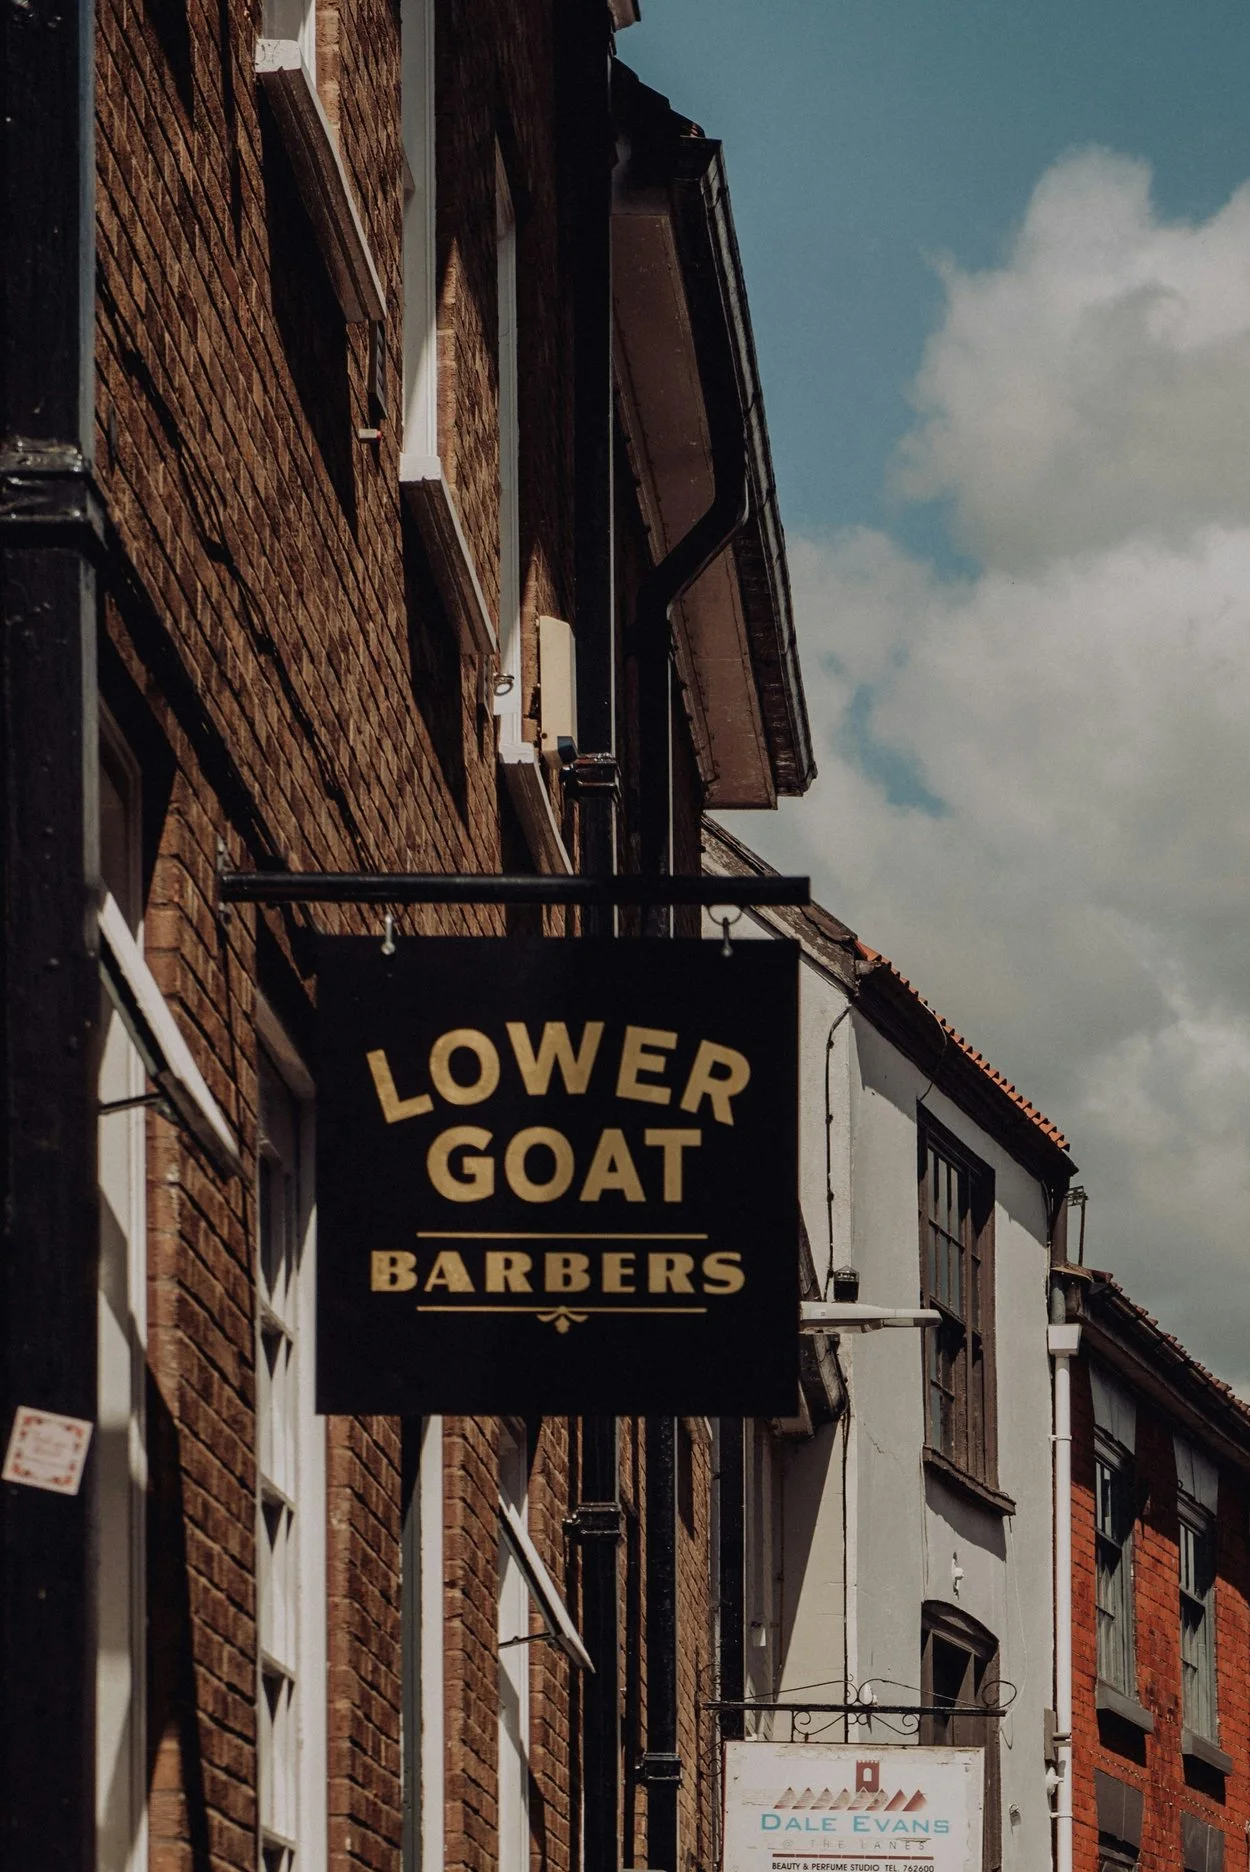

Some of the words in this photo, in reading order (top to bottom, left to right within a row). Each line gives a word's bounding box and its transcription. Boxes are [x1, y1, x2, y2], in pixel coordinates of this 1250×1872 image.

[366, 1021, 751, 1125] LOWER
[427, 1125, 702, 1203] GOAT
[371, 1250, 746, 1295] BARBERS
[761, 1813, 837, 1832] DALE
[853, 1815, 950, 1834] EVANS
[810, 1839, 845, 1849] THE
[861, 1840, 925, 1850] LANES
[772, 1862, 800, 1871] BEAUTY
[803, 1863, 809, 1871] &
[811, 1863, 848, 1872] PERFUME
[850, 1864, 880, 1872] STUDIO
[903, 1864, 935, 1872] 762600
